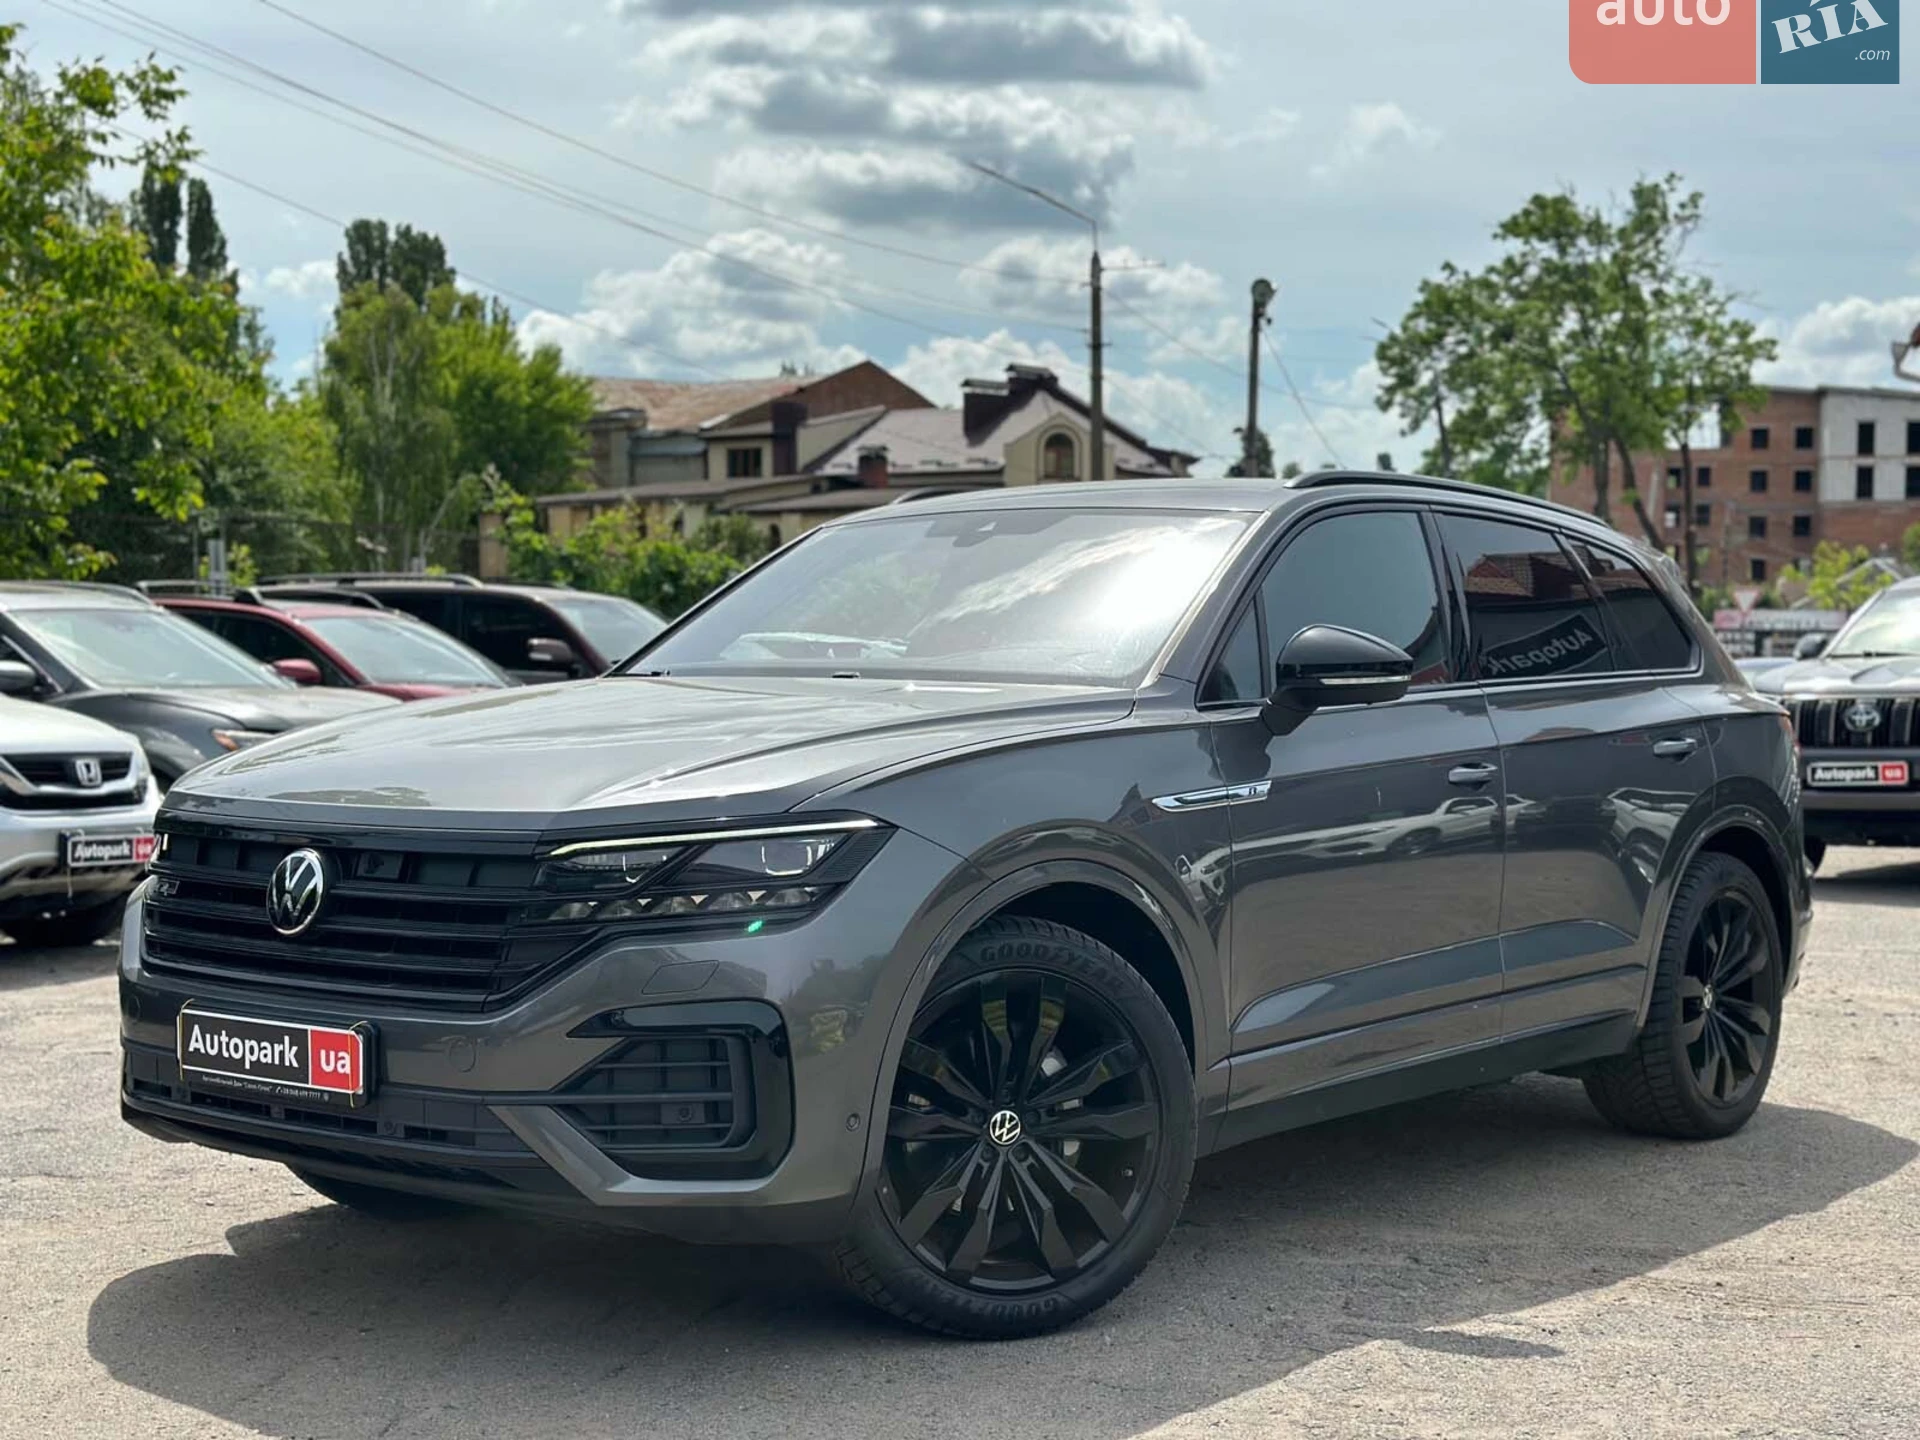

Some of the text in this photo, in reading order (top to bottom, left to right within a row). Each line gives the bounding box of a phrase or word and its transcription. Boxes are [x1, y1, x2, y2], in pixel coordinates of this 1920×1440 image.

[1814, 766, 1875, 781] Autopark
[74, 840, 131, 861] Autopark
[188, 1024, 351, 1074] Autopark ua
